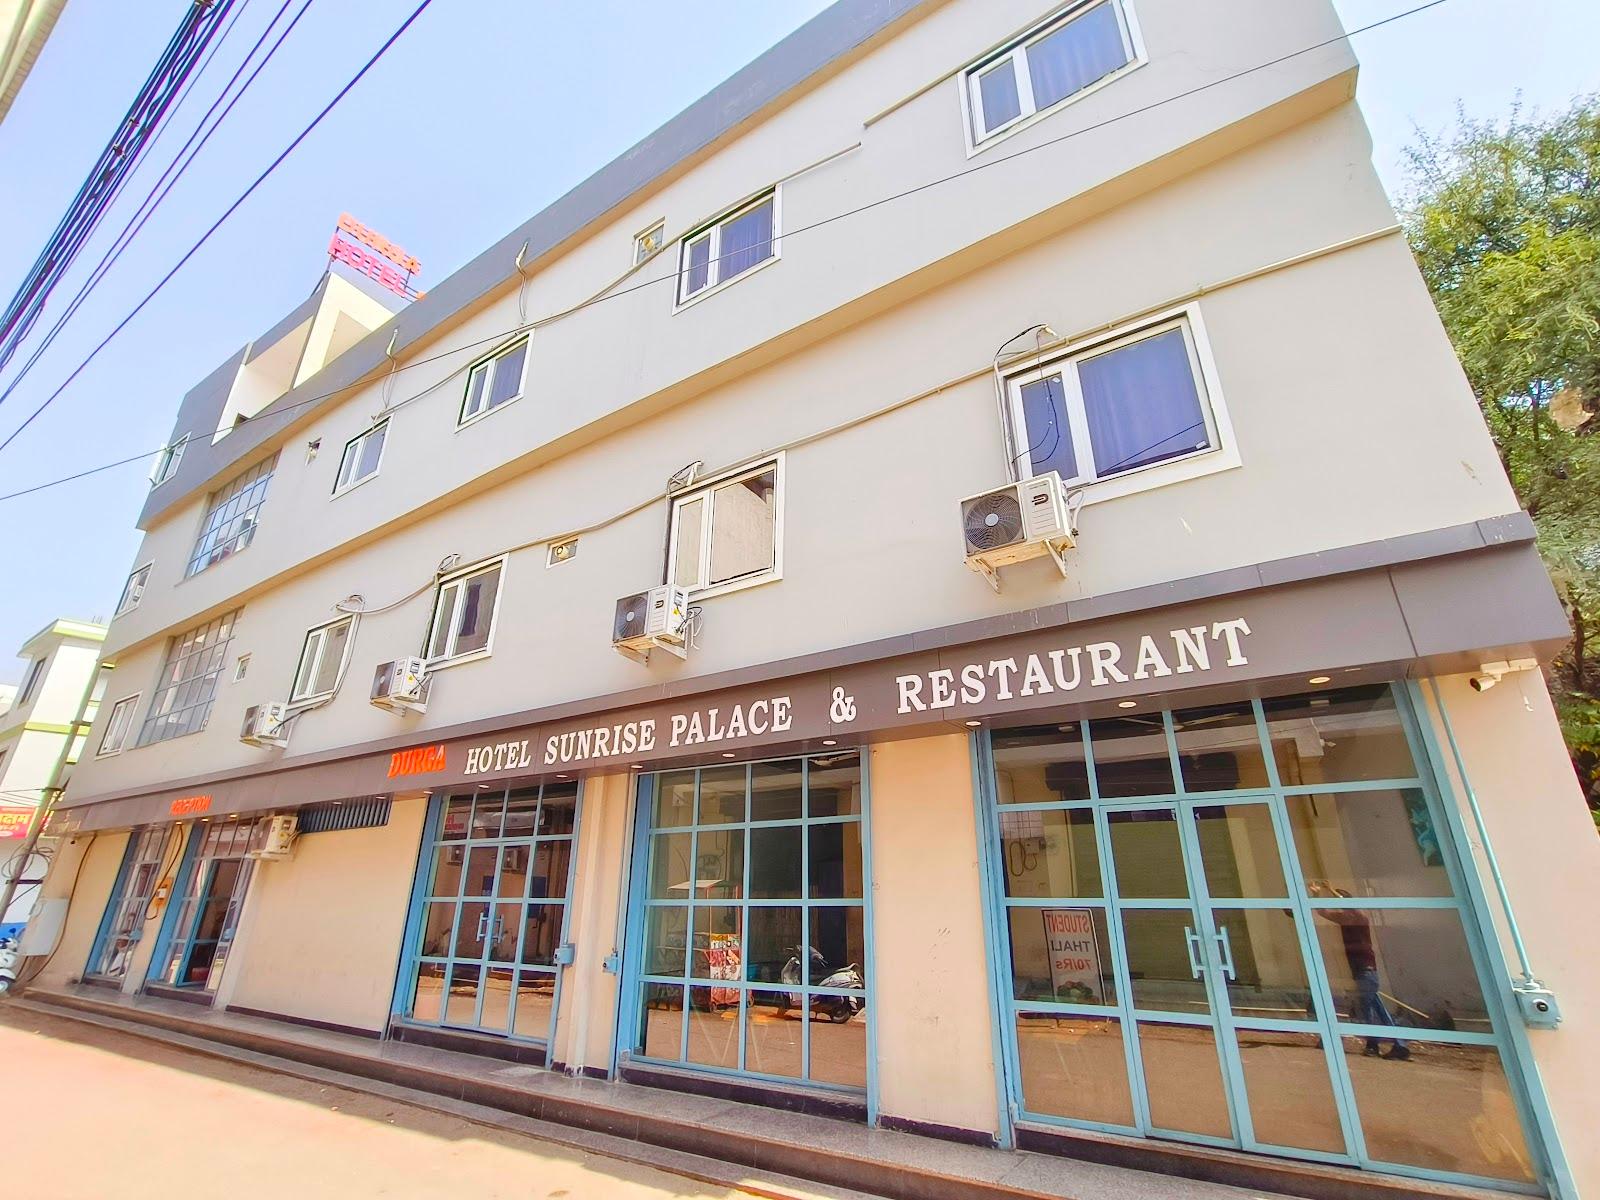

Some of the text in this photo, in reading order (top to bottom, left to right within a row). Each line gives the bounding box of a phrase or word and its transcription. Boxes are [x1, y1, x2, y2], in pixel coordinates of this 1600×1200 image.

[387, 617, 1252, 778] DURGA HOTEL SUNRISE PALACE & RESTAURANT
